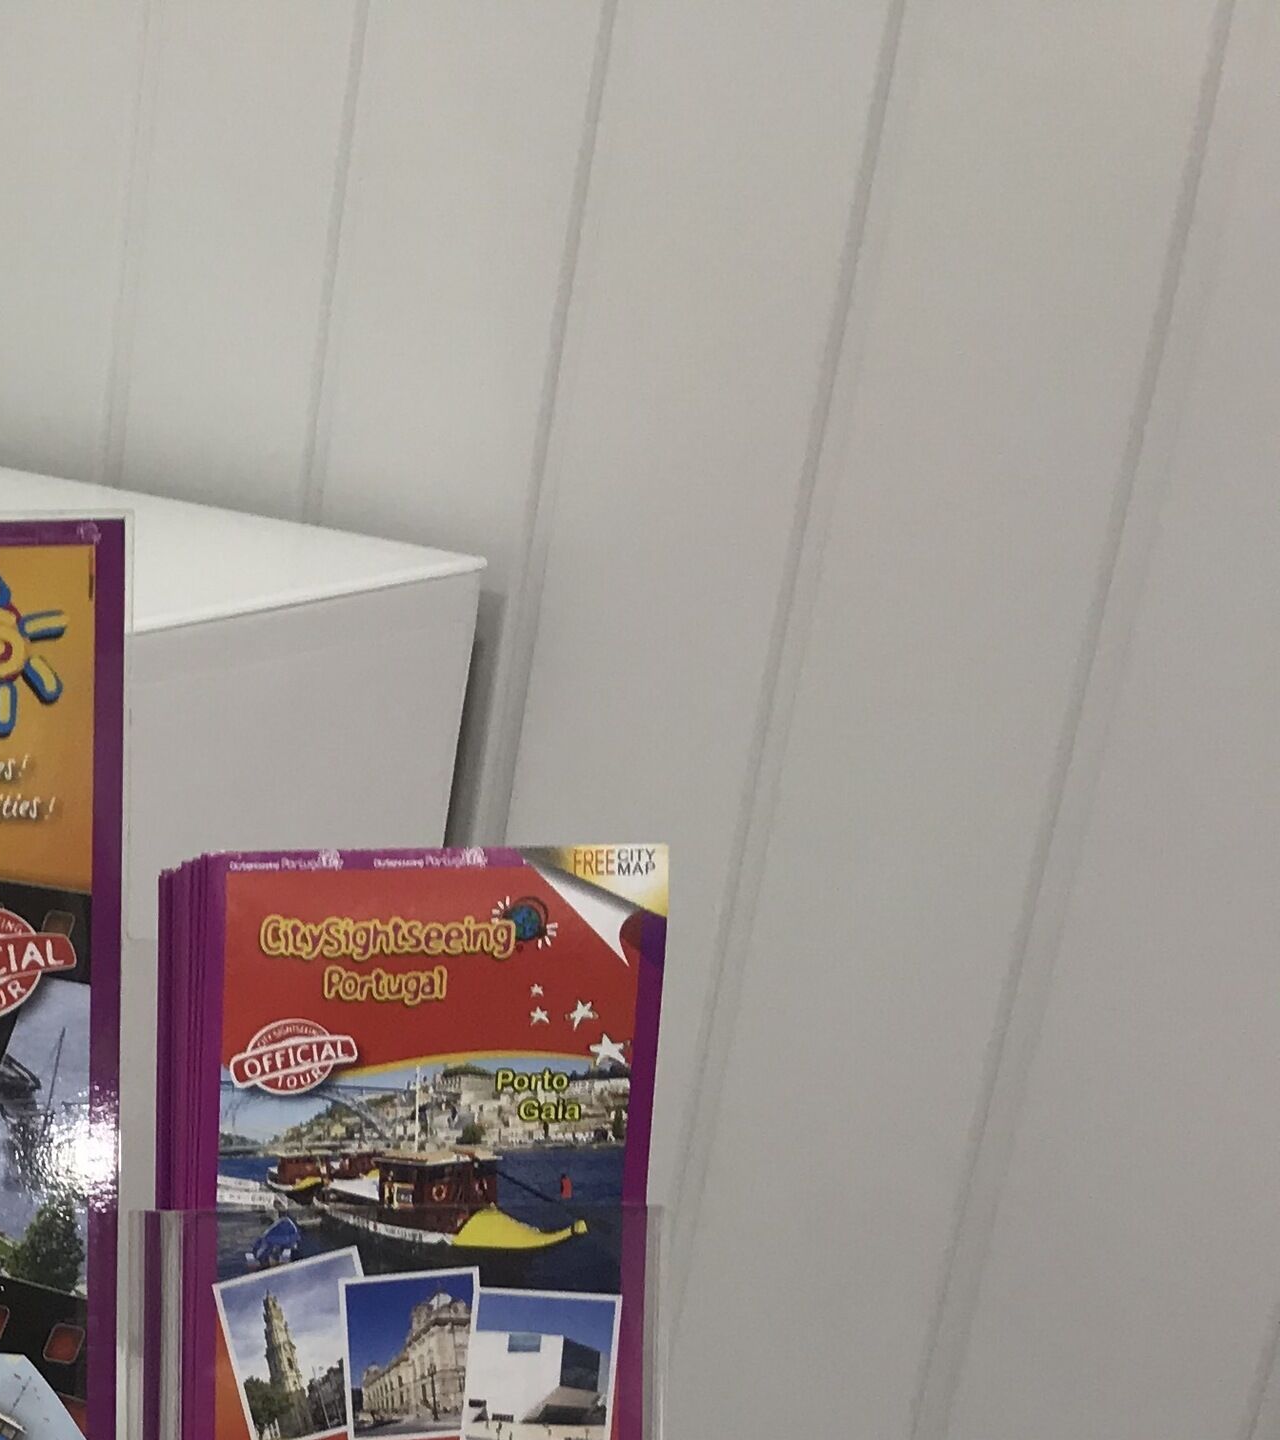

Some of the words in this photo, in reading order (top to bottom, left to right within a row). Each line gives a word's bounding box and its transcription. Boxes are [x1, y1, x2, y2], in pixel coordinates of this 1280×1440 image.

[573, 849, 615, 875] FREE
[618, 848, 656, 862] CITY
[617, 862, 656, 876] MAP
[260, 915, 516, 960] CitySightseeing
[324, 965, 448, 1006] Portugal
[244, 1040, 349, 1078] OFFICIAL
[277, 1066, 324, 1089] TOUR
[496, 1068, 569, 1094] Porto
[517, 1099, 581, 1123] Gaia
